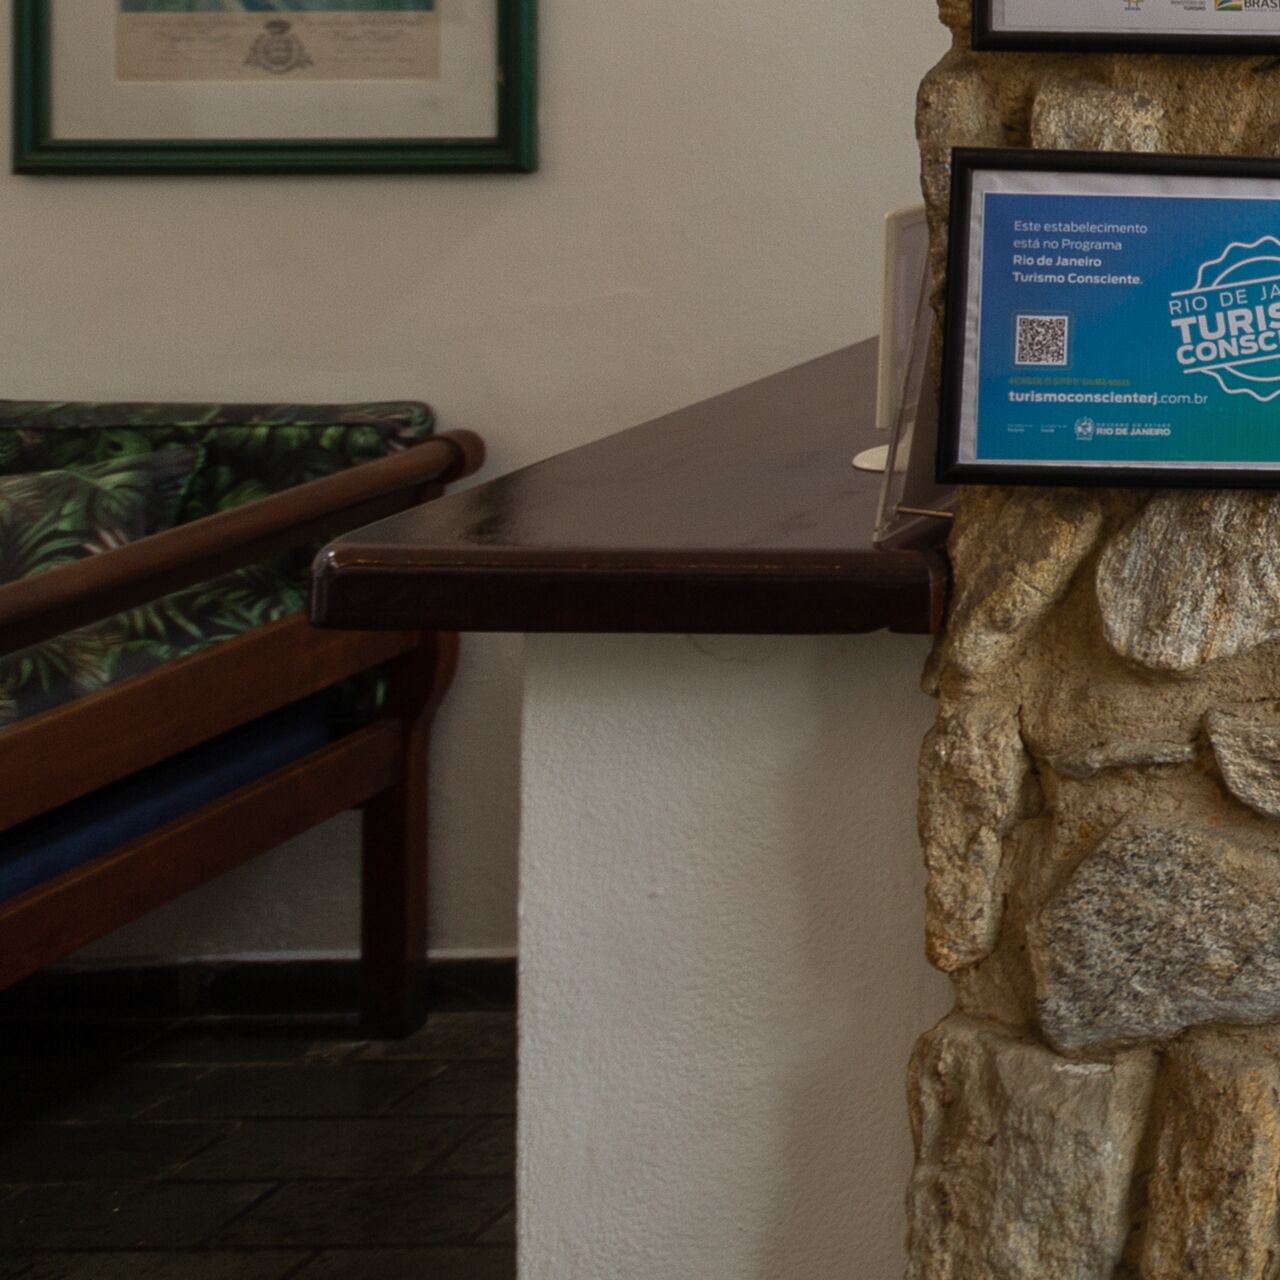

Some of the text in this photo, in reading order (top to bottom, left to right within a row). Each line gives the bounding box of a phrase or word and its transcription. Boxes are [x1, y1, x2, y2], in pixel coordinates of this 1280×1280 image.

[1014, 220, 1148, 234] Este estabelecimento
[1013, 239, 1122, 251] está no Programa
[1013, 255, 1102, 267] Rio de Janeiro
[1012, 272, 1143, 285] Turismo Consciente.
[1169, 296, 1208, 315] RIO
[1219, 289, 1248, 307] DE
[1008, 390, 1208, 405] turismoconscienterj.com.br
[1130, 428, 1171, 436] JANEIRO
